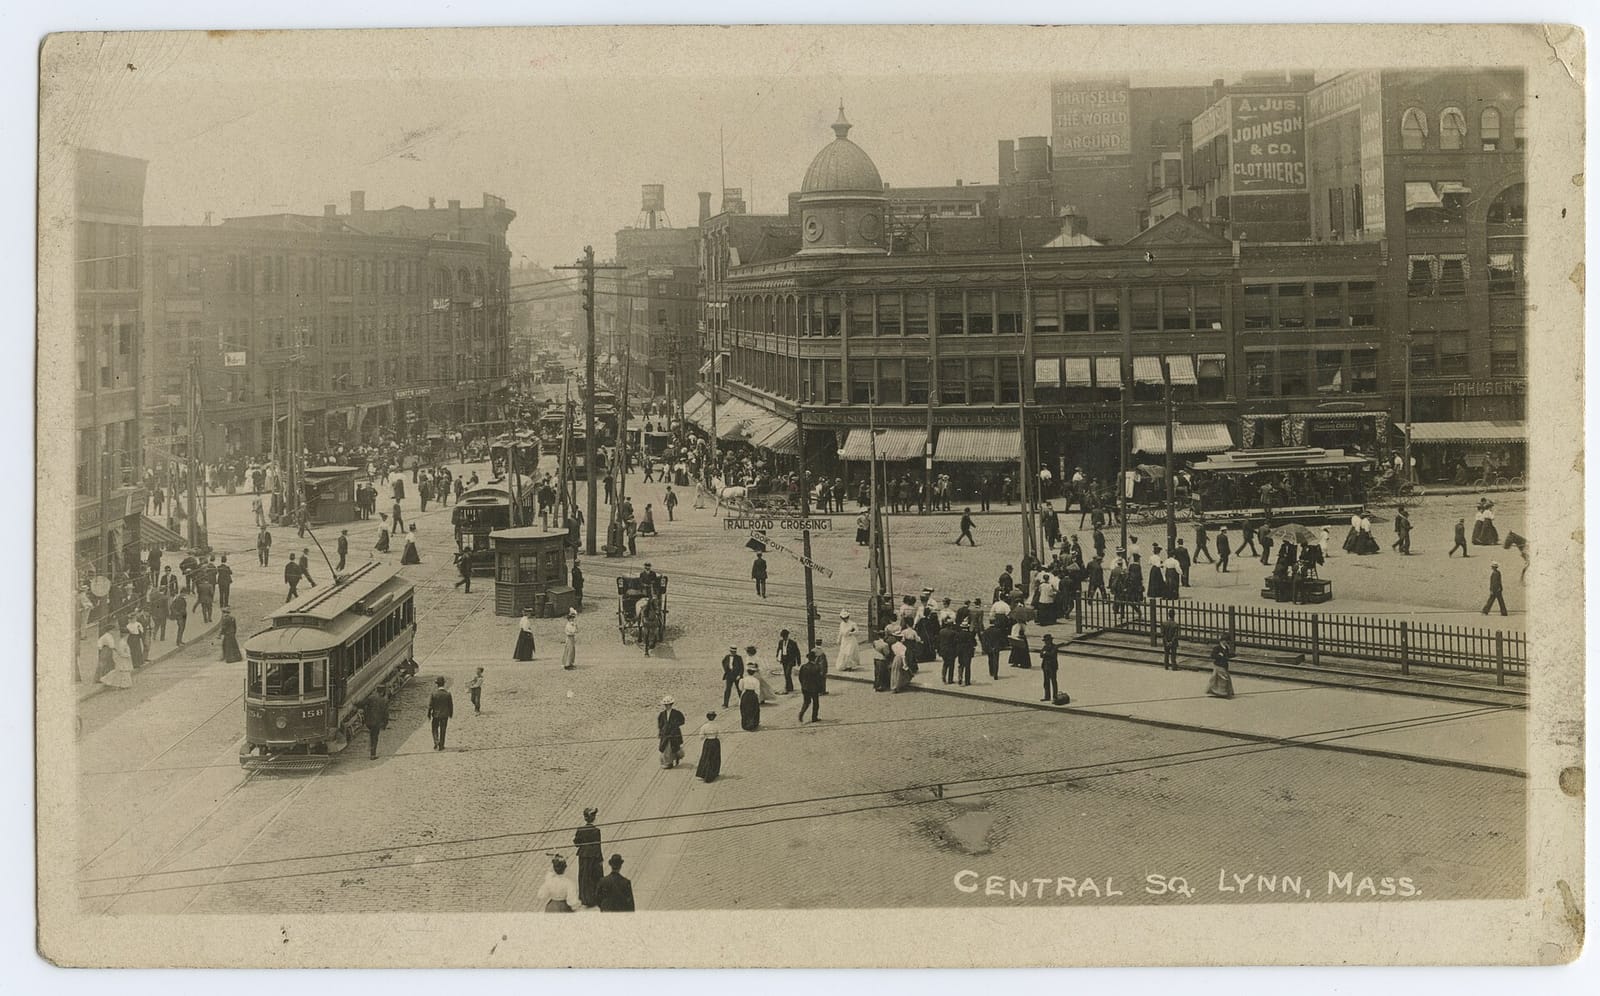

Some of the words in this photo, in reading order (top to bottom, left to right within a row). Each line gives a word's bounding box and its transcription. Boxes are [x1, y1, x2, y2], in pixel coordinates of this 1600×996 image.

[1090, 90, 1127, 104] SELLS
[1238, 99, 1258, 111] A.
[1056, 113, 1080, 127] THE
[1082, 112, 1127, 126] WORLD
[1233, 116, 1303, 143] JOHNSON
[1250, 144, 1263, 155] &
[1268, 144, 1297, 154] CO.
[1233, 162, 1304, 185] CLOTHIERS
[727, 520, 774, 530] RAILROAD
[781, 520, 828, 530] CROSSING
[771, 541, 786, 552] OUT
[302, 709, 324, 719] 158
